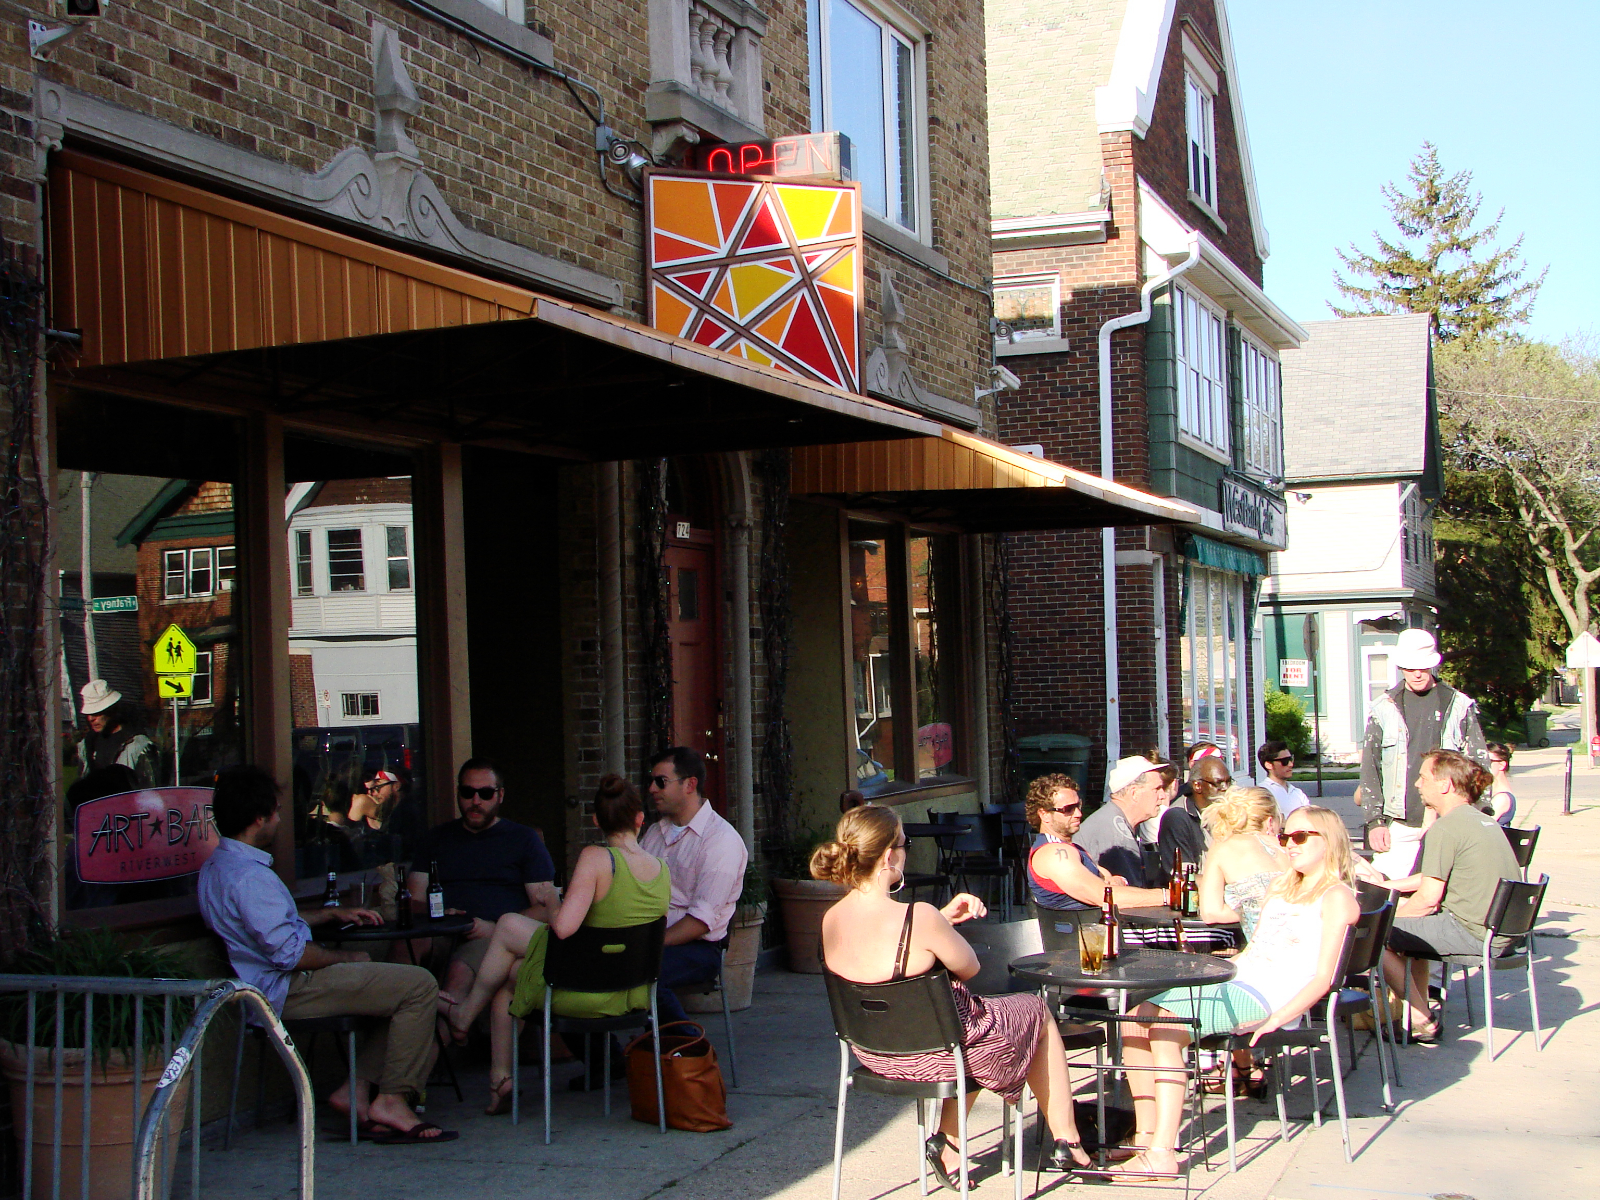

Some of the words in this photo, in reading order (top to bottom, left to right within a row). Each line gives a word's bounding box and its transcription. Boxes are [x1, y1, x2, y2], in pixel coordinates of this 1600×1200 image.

[709, 136, 832, 176] OPEN
[677, 523, 690, 537] 724
[88, 813, 149, 857] ART
[167, 804, 222, 846] BAR
[120, 852, 196, 872] RIVERWEST
